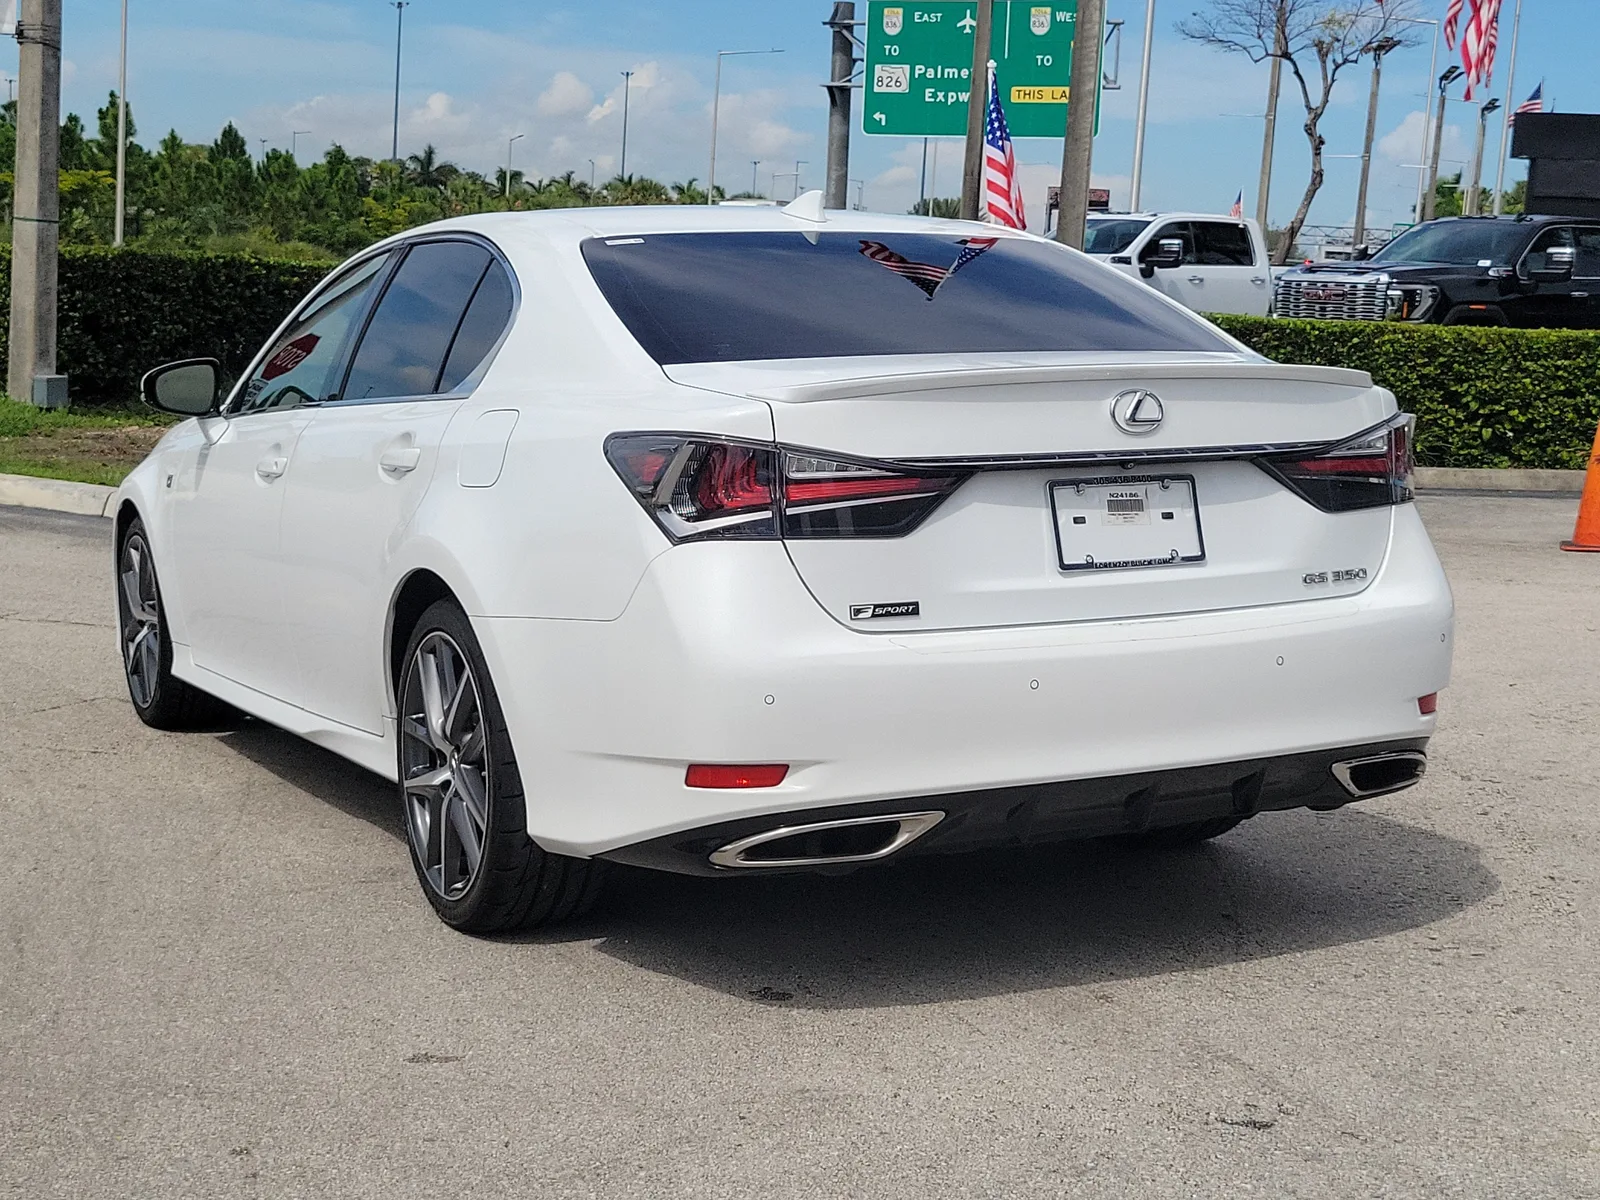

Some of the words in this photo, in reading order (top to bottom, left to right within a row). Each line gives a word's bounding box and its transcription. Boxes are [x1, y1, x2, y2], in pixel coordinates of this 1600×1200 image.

[914, 12, 942, 22] EAST
[1033, 19, 1045, 28] 836
[884, 45, 900, 56] TO
[1036, 55, 1053, 66] TO
[915, 65, 973, 79] Palme
[876, 75, 902, 88] 826
[925, 88, 971, 106] Expw
[1016, 89, 1044, 100] THIS
[1051, 89, 1068, 100] LA
[1302, 572, 1328, 585] GS
[1331, 568, 1367, 582] 350
[874, 605, 916, 615] SPORT
